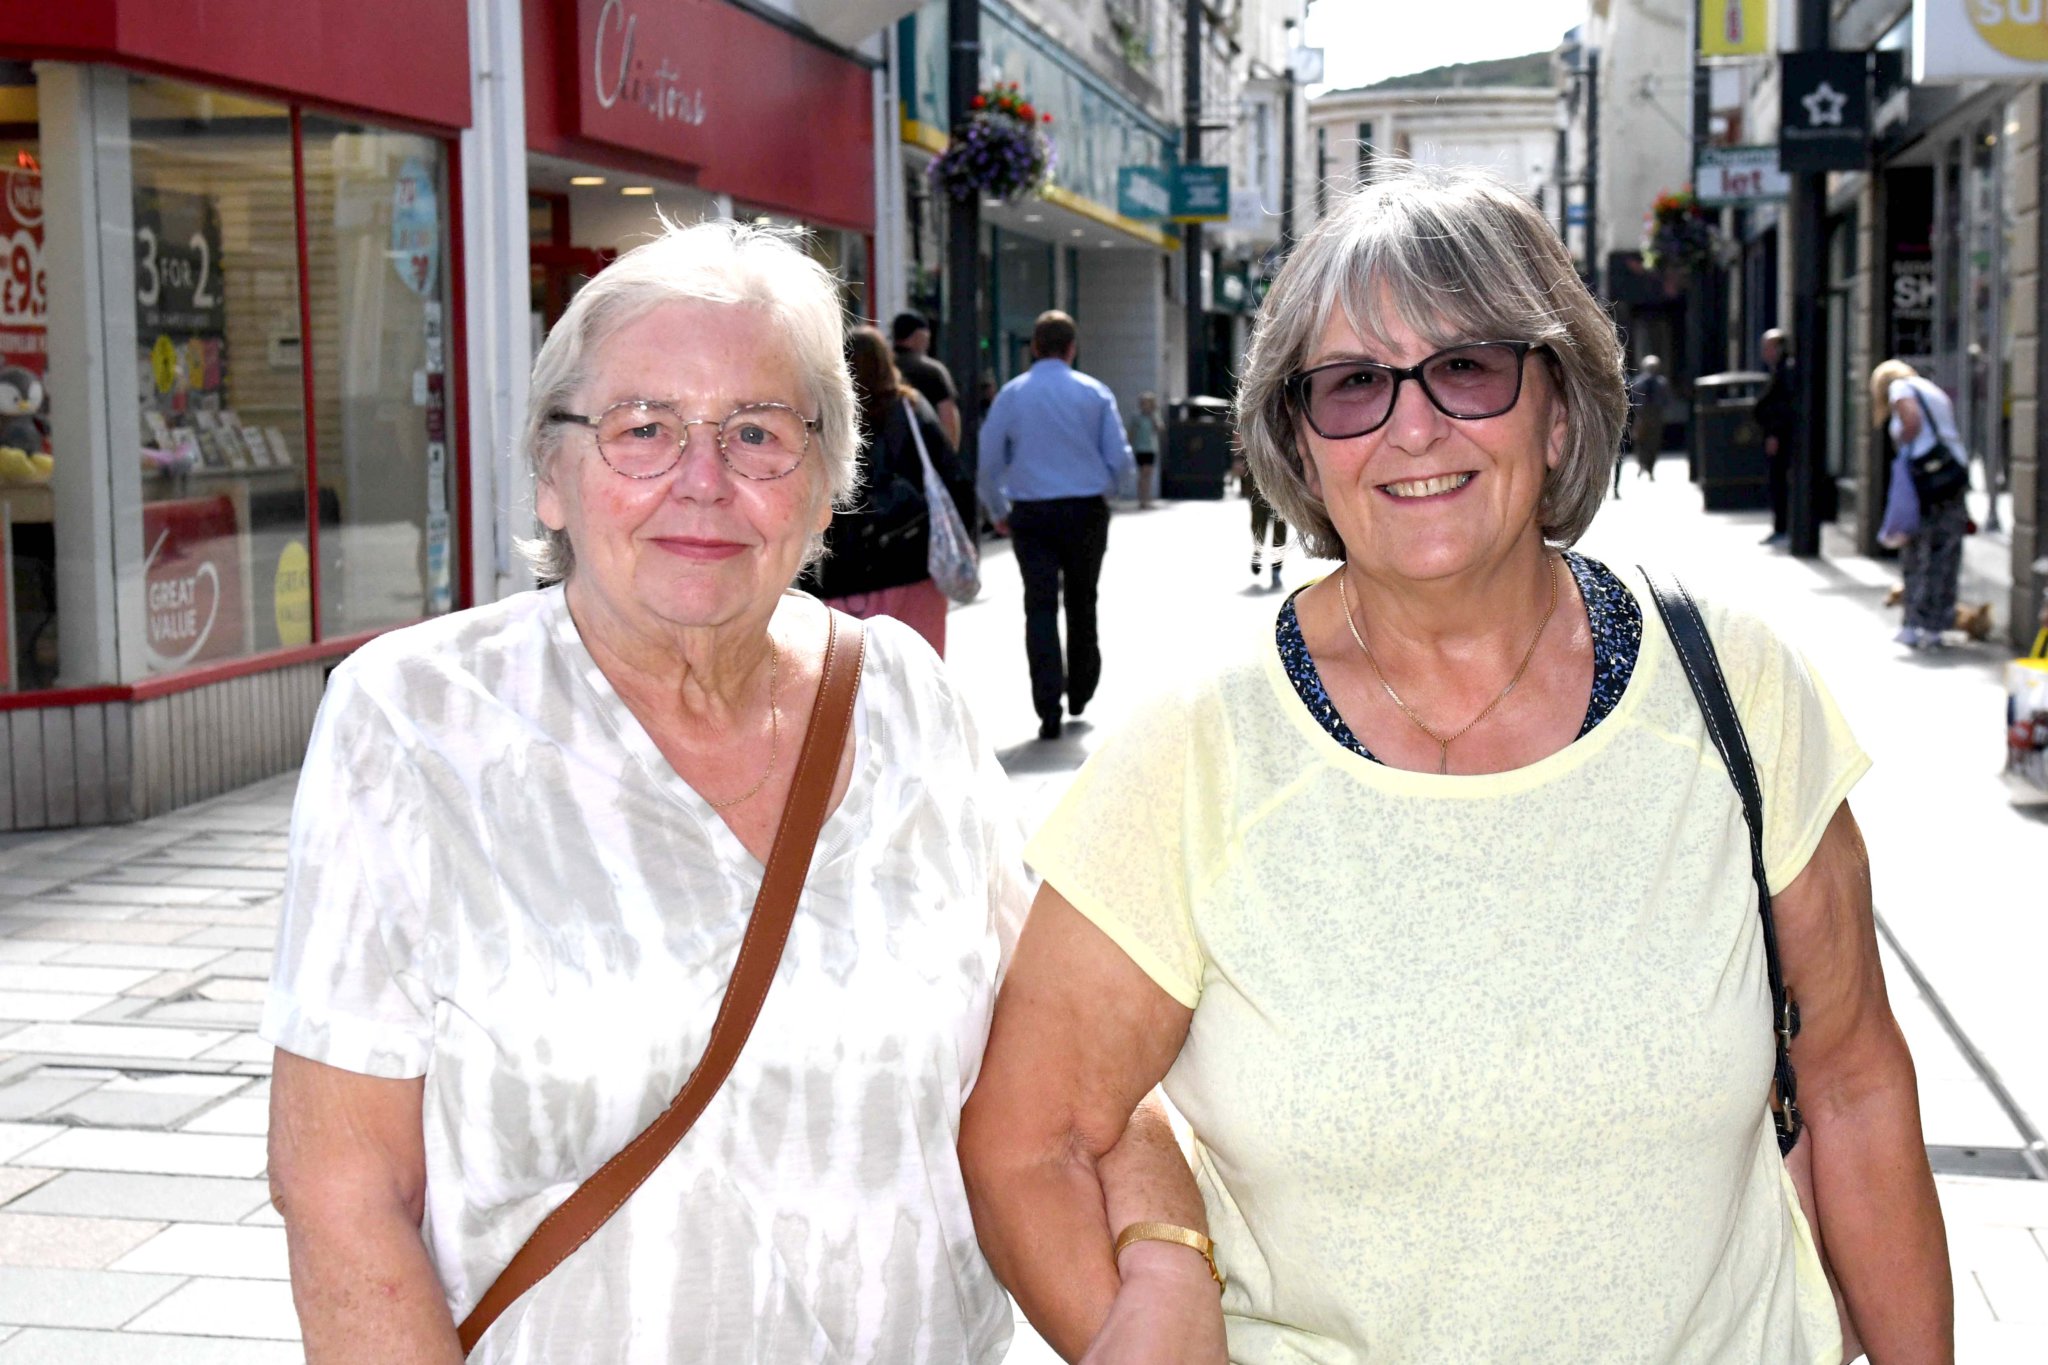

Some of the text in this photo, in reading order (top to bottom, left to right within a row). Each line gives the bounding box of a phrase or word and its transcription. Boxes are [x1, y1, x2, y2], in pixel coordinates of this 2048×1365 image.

[1978, 0, 2048, 25] su
[138, 227, 160, 305] 3
[160, 258, 192, 288] FOR
[150, 577, 196, 610] GREAT
[150, 609, 197, 641] VALUE
